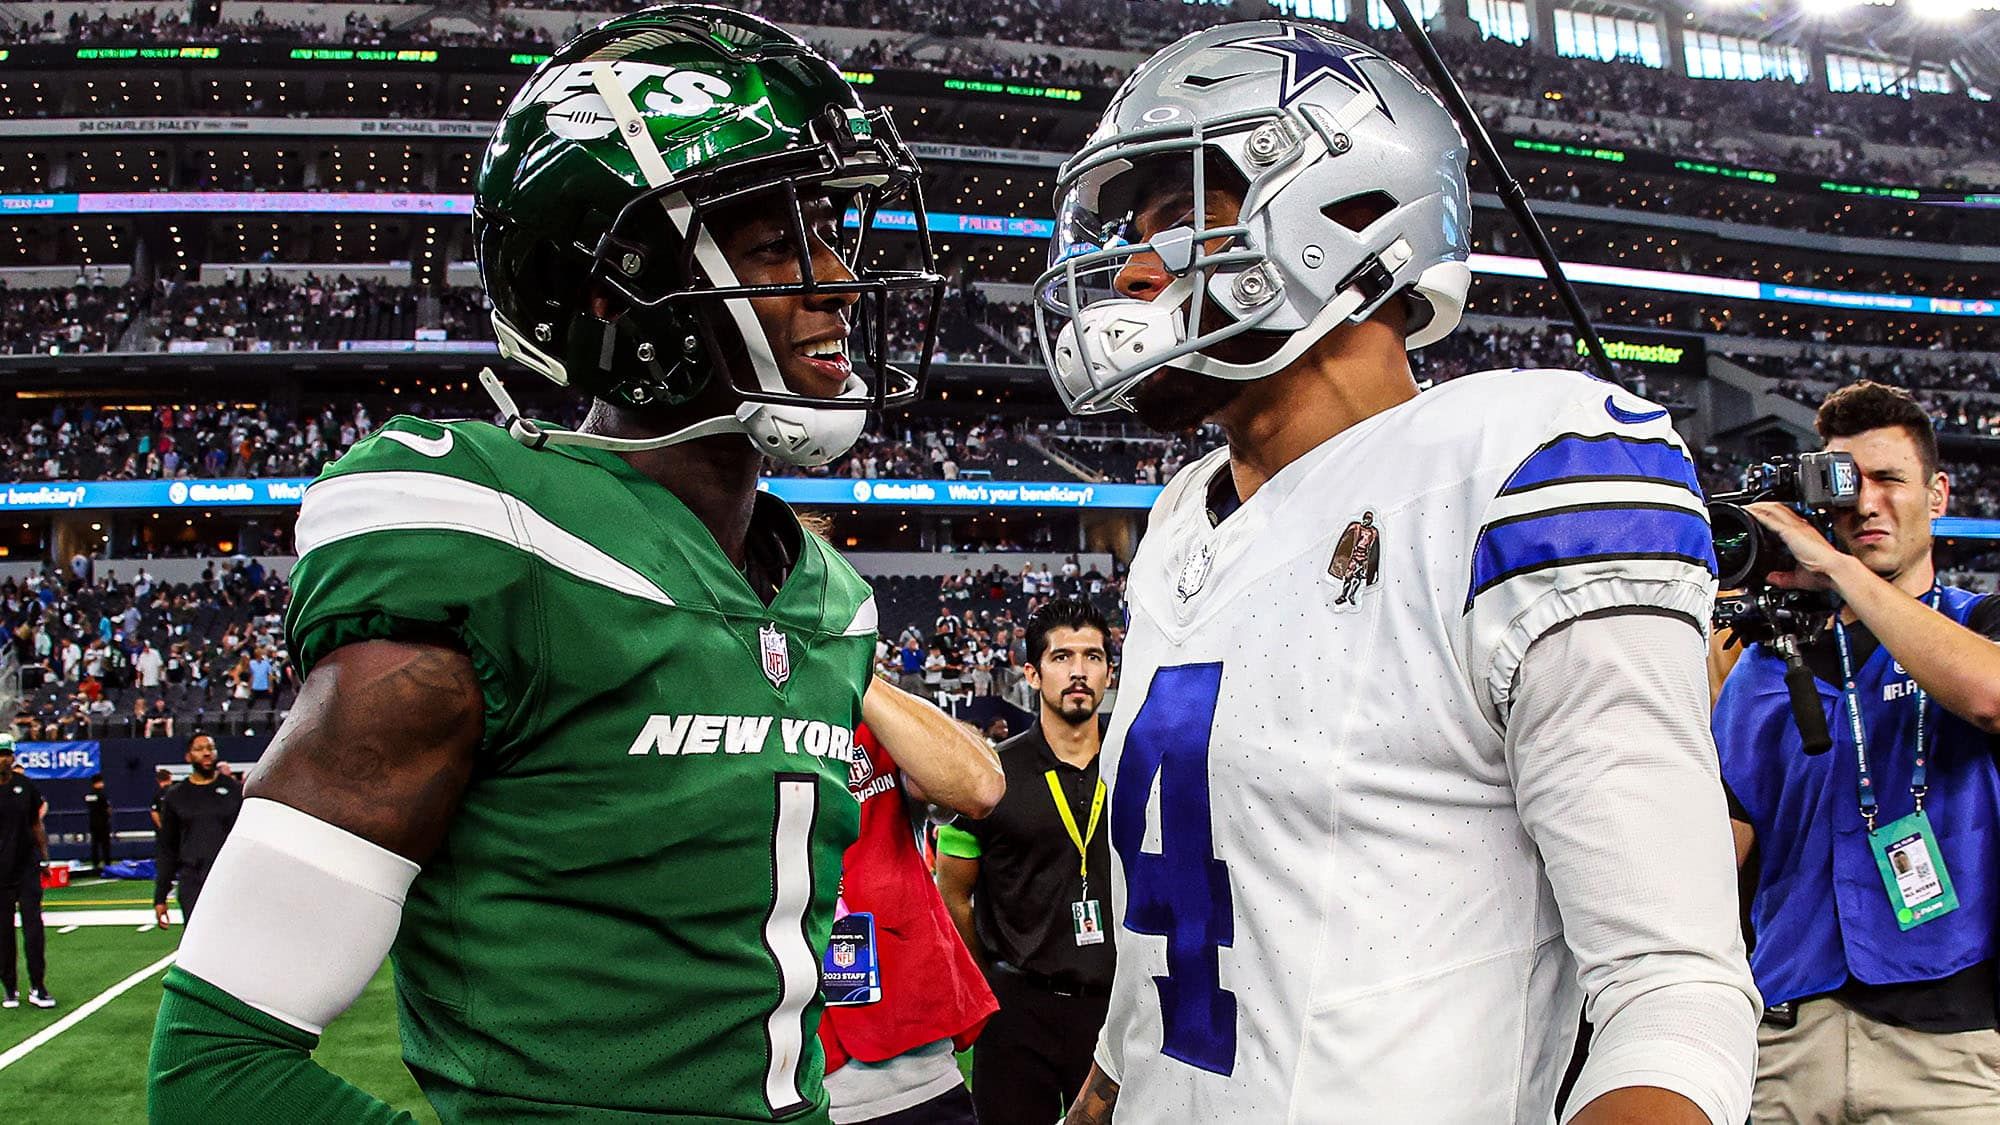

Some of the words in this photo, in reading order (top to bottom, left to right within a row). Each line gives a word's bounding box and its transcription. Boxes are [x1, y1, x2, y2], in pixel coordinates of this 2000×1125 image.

[97, 121, 154, 131] CHARLES
[158, 120, 200, 130] HALEY
[379, 122, 434, 133] MICHAEL
[438, 123, 472, 133] IRVIN
[960, 147, 996, 160] SMITH
[948, 485, 988, 501] Who's
[989, 489, 1018, 505] your
[1019, 485, 1094, 506] beneficiary?
[768, 651, 788, 676] NFL
[1883, 682, 1905, 701] NFL
[628, 714, 774, 756] NEW
[781, 718, 854, 763] YOR
[16, 752, 50, 769] CBS
[59, 751, 94, 768] NFL
[1110, 661, 1237, 1077] 4
[760, 772, 818, 1118] 1
[836, 953, 852, 964] NFL
[823, 972, 841, 980] 2023
[842, 972, 866, 980] STAFF
